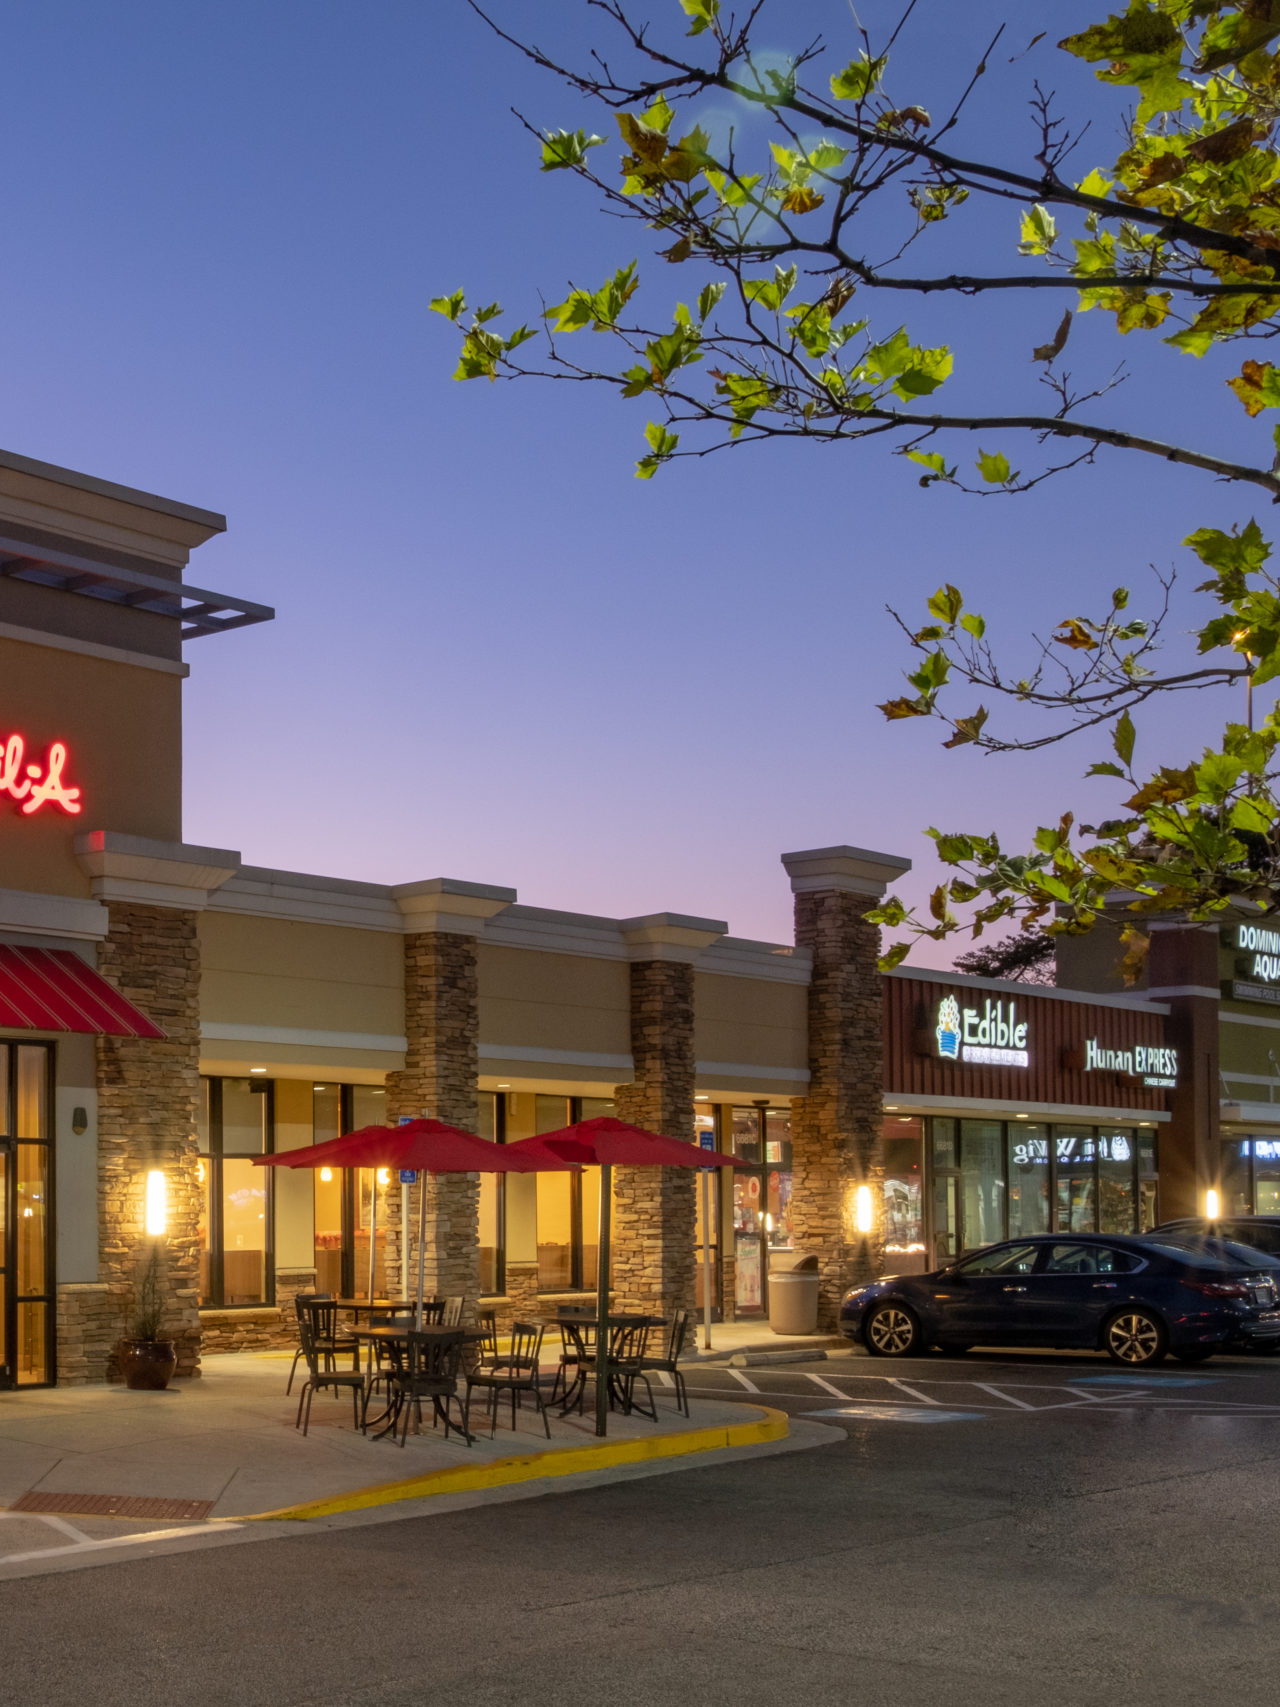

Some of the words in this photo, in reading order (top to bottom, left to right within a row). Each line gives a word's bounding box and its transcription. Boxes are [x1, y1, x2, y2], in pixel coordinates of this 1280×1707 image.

[1239, 925, 1280, 954] DOMINI
[963, 998, 1027, 1049] Edible
[1084, 1036, 1137, 1077] Hunan
[1135, 1046, 1178, 1076] EXPRESS
